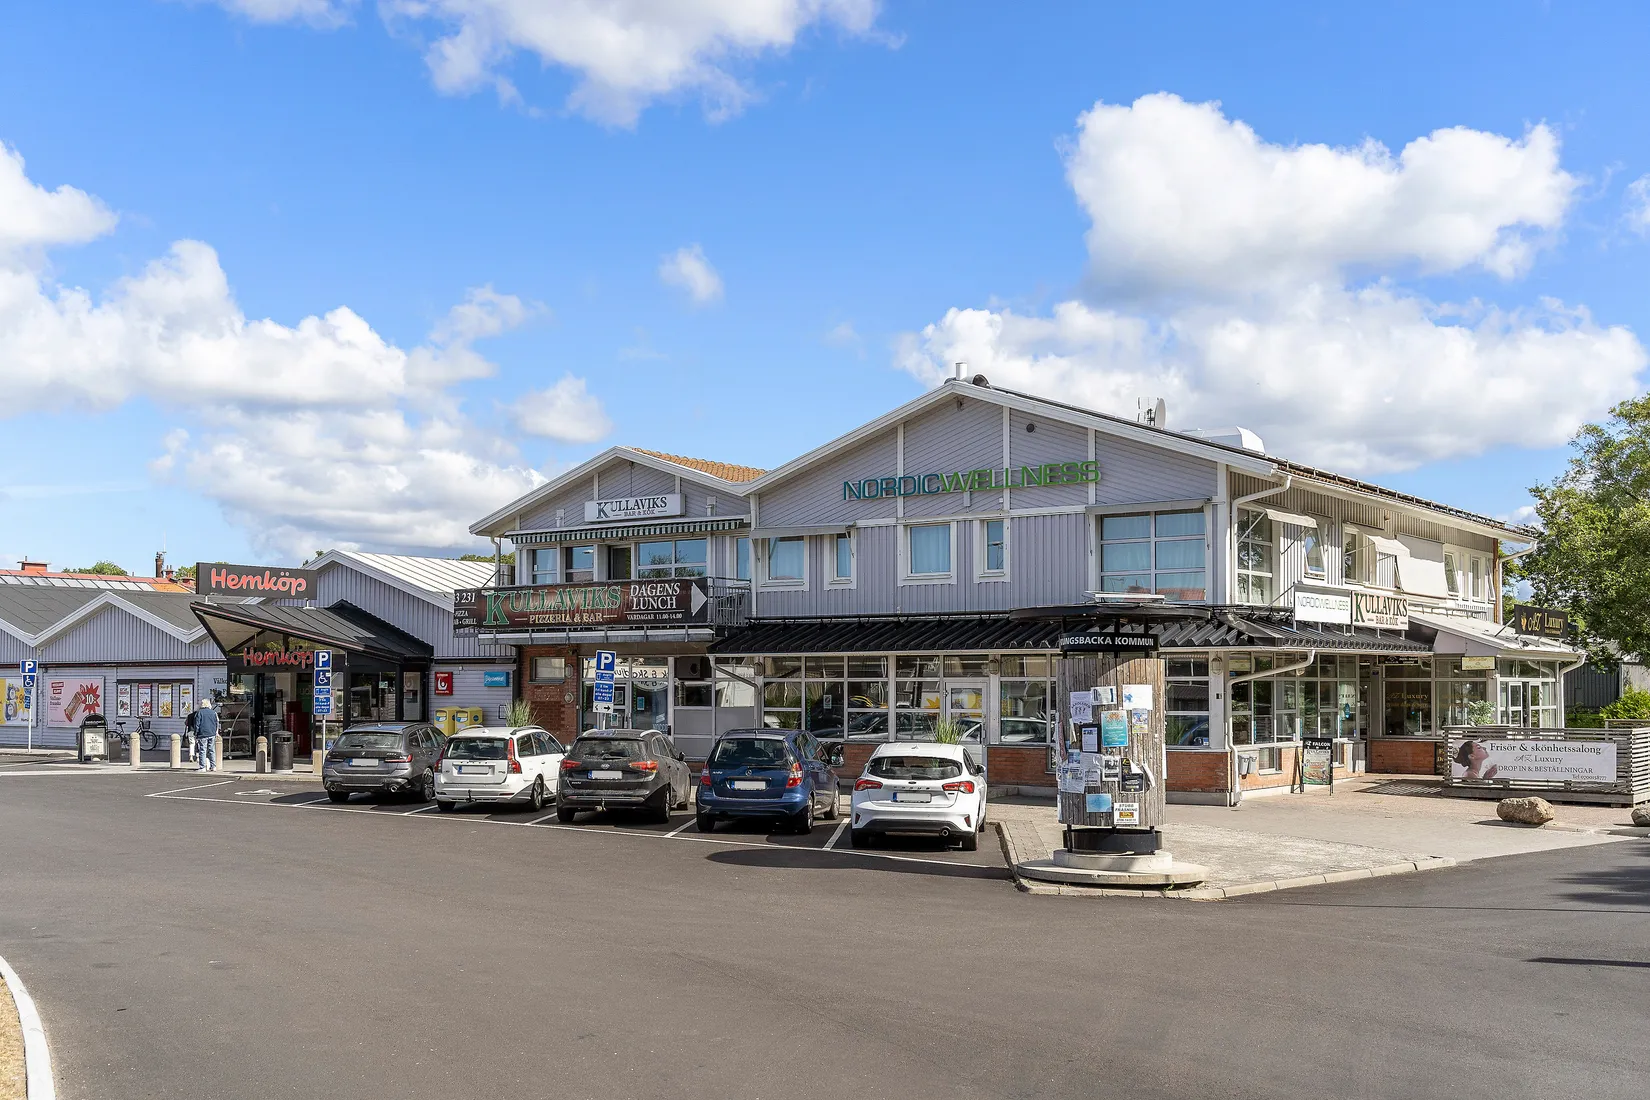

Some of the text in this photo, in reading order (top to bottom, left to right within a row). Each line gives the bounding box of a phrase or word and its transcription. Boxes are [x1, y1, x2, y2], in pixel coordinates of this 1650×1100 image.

[843, 461, 1100, 500] NORDICWELLNESS
[596, 496, 667, 520] KULLAVIKS
[210, 567, 307, 596] Hemköp
[630, 582, 681, 597] DAGENS
[461, 591, 476, 604] 231
[482, 584, 622, 626] KULLAVIKS
[632, 595, 677, 610] LUNCH
[1353, 592, 1408, 623] KULLAVIKS
[529, 613, 572, 624] PIZZERIA
[582, 612, 603, 622] BAR
[1375, 615, 1385, 624] BAR
[1115, 637, 1154, 646] KOMMUN
[242, 645, 314, 670] Hemköp
[319, 652, 329, 667] P
[601, 653, 612, 669] P
[25, 661, 34, 673] P
[1490, 743, 1601, 755] Frisör & skönhetssalong
[1534, 755, 1563, 764] Luxury
[1534, 765, 1593, 774] BESTÄLLNINGAR
